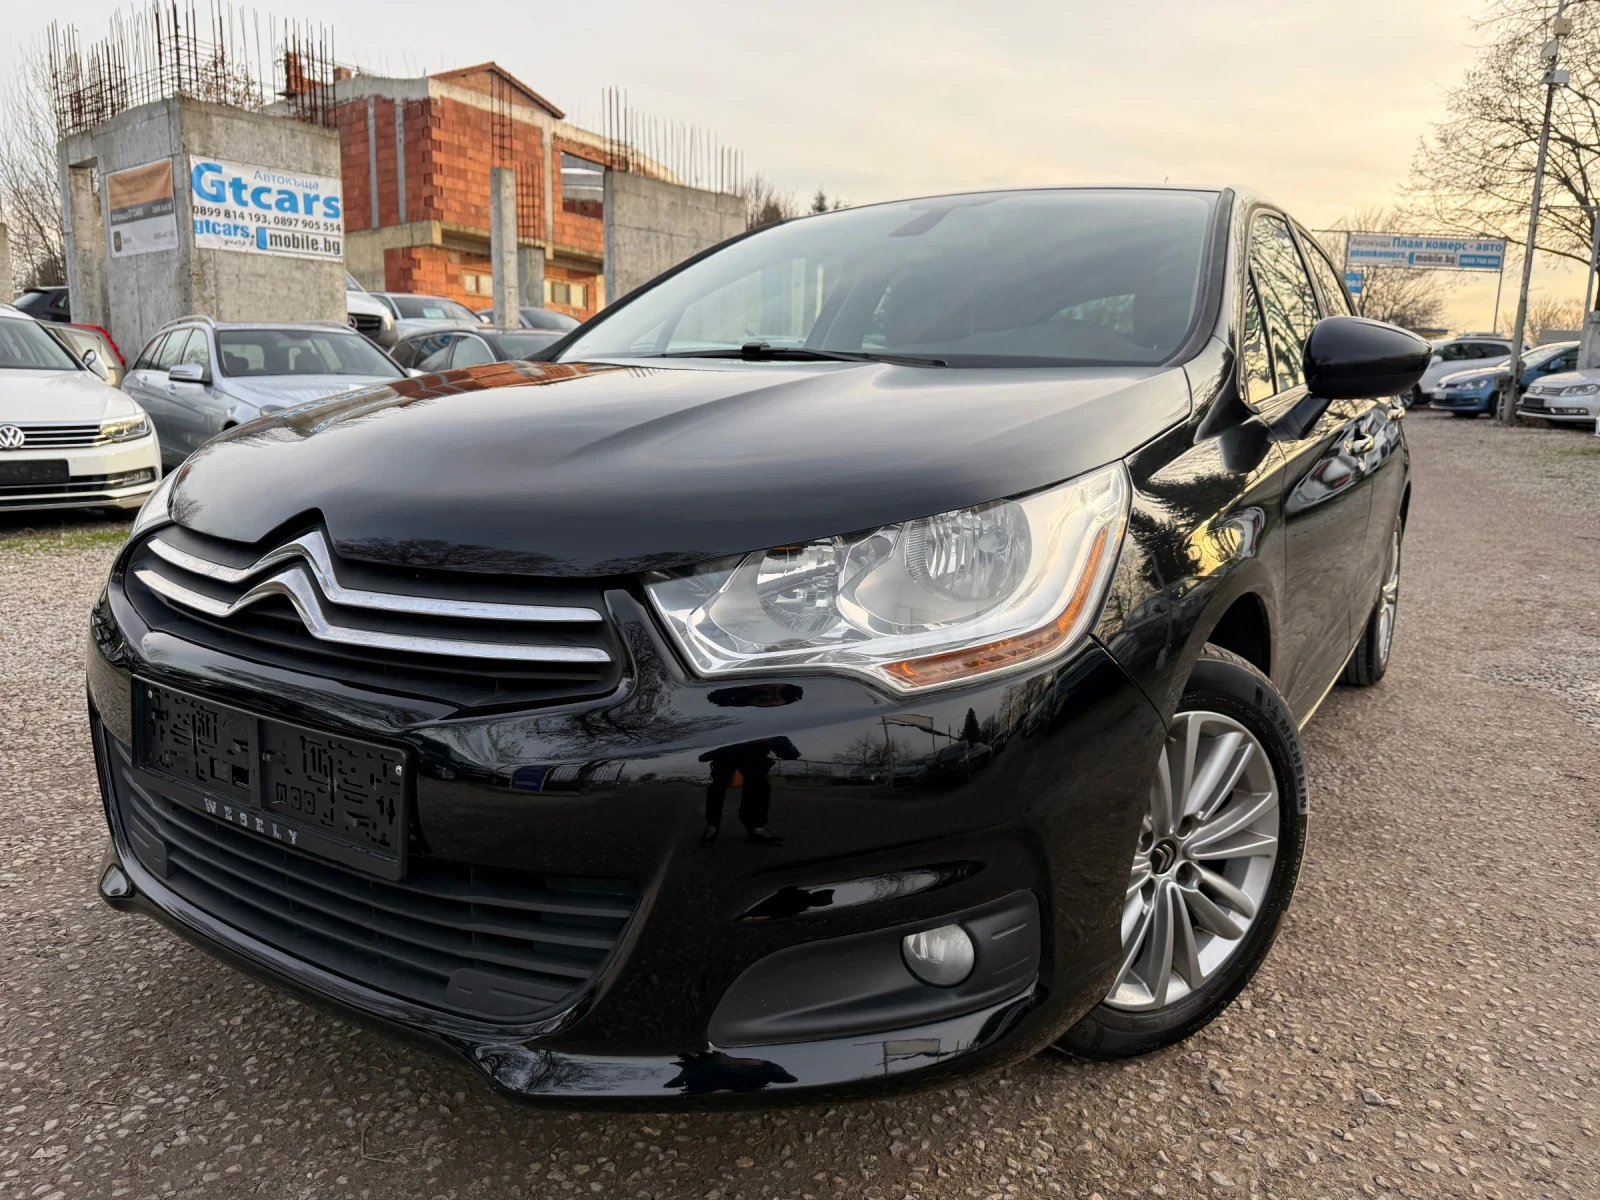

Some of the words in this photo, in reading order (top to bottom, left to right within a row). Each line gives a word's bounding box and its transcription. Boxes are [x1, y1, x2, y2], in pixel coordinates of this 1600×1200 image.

[191, 162, 341, 218] Gtcars
[254, 170, 319, 190] Автокъща
[193, 205, 221, 217] 0899
[224, 209, 245, 220] 814
[248, 212, 271, 224] 193,
[273, 216, 299, 227] 0897
[301, 219, 320, 229] 905
[323, 222, 341, 233] 554
[269, 233, 340, 255] mobile.bg
[1392, 237, 1423, 248] Плам
[1426, 241, 1467, 252] комерс
[1476, 243, 1503, 252] авто
[1278, 718, 1307, 810] MICHELIN
[203, 798, 298, 845] WESELY
